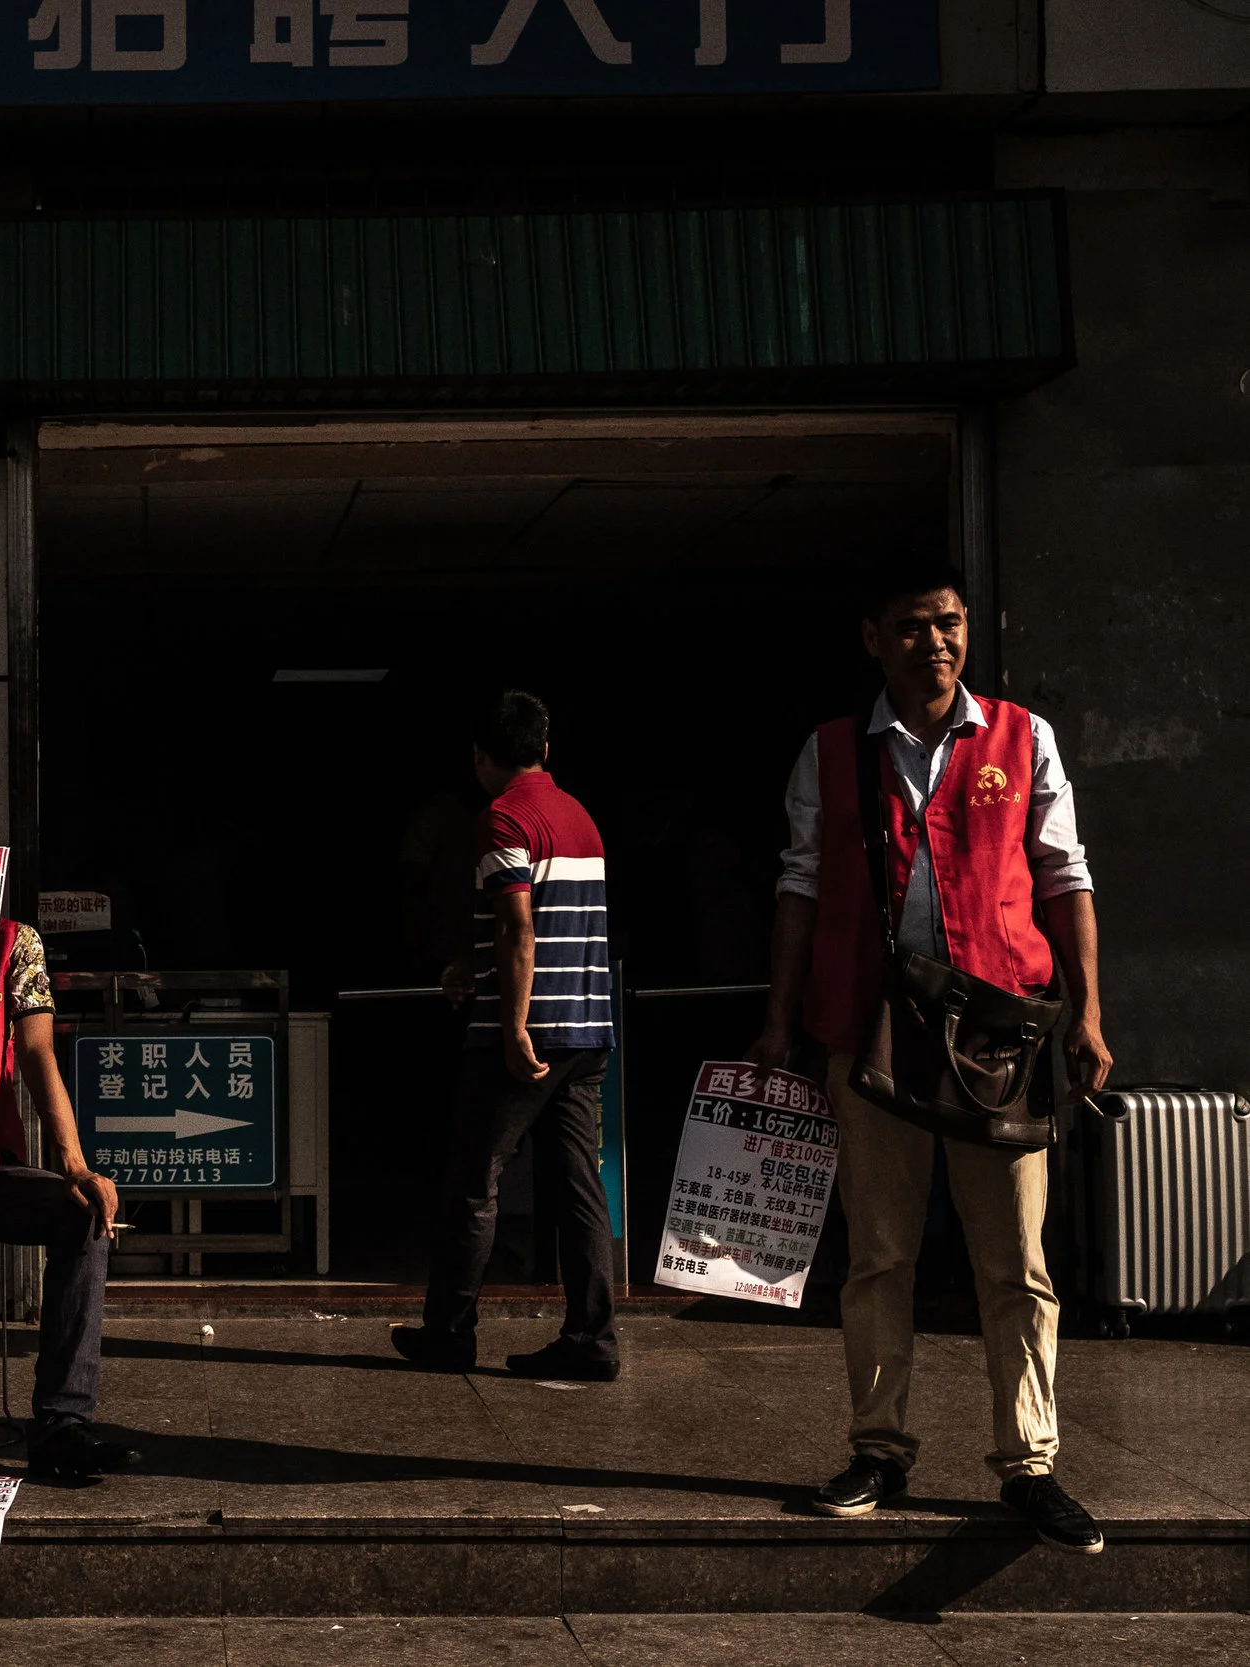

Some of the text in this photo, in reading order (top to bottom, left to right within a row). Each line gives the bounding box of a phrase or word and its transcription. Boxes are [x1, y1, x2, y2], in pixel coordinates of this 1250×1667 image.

[98, 1041, 254, 1069] 求职人员
[98, 1072, 254, 1100] 登记入场
[689, 1099, 838, 1148] 工价：16元/小时
[95, 1148, 253, 1166] 劳动信访投诉电话：
[743, 1134, 835, 1168] 进厂借支100元
[109, 1167, 223, 1183] 27707113
[706, 1165, 827, 1202] 18-45岁，本人证件有磁
[760, 1157, 831, 1188] 包吃包住
[671, 1198, 820, 1239] 主要做医疗器材装配坐班/两班
